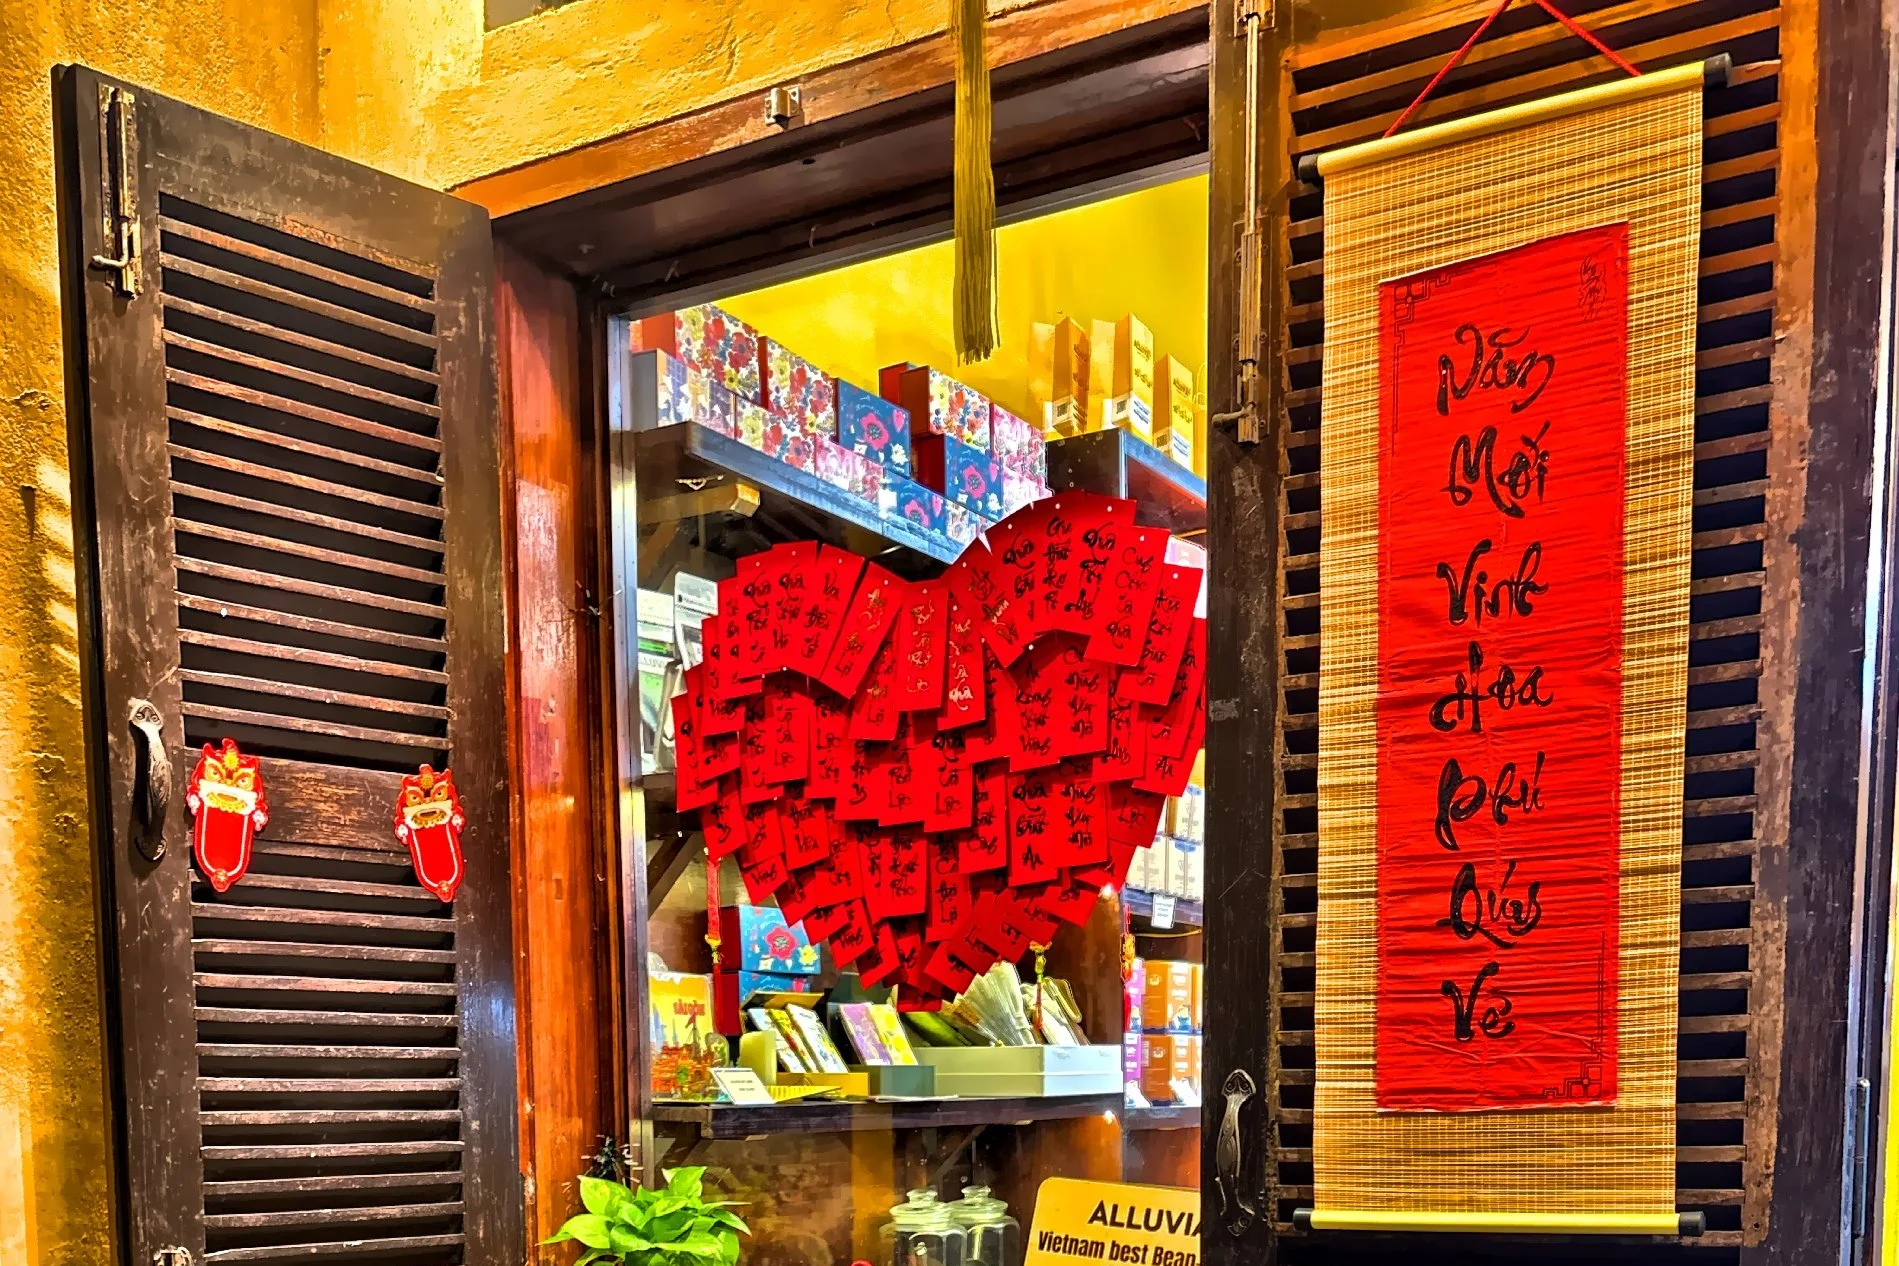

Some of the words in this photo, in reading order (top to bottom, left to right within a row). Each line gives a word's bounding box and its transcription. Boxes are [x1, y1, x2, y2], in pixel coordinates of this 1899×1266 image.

[1437, 324, 1556, 416] Năm
[1440, 421, 1550, 518] Mới
[1437, 539, 1549, 629] Vinh
[1429, 640, 1554, 734] Hoa
[1435, 751, 1546, 851] Phú
[1436, 860, 1543, 950] Quý
[1038, 1230, 1105, 1259] Vietnam
[1108, 1240, 1148, 1265] best
